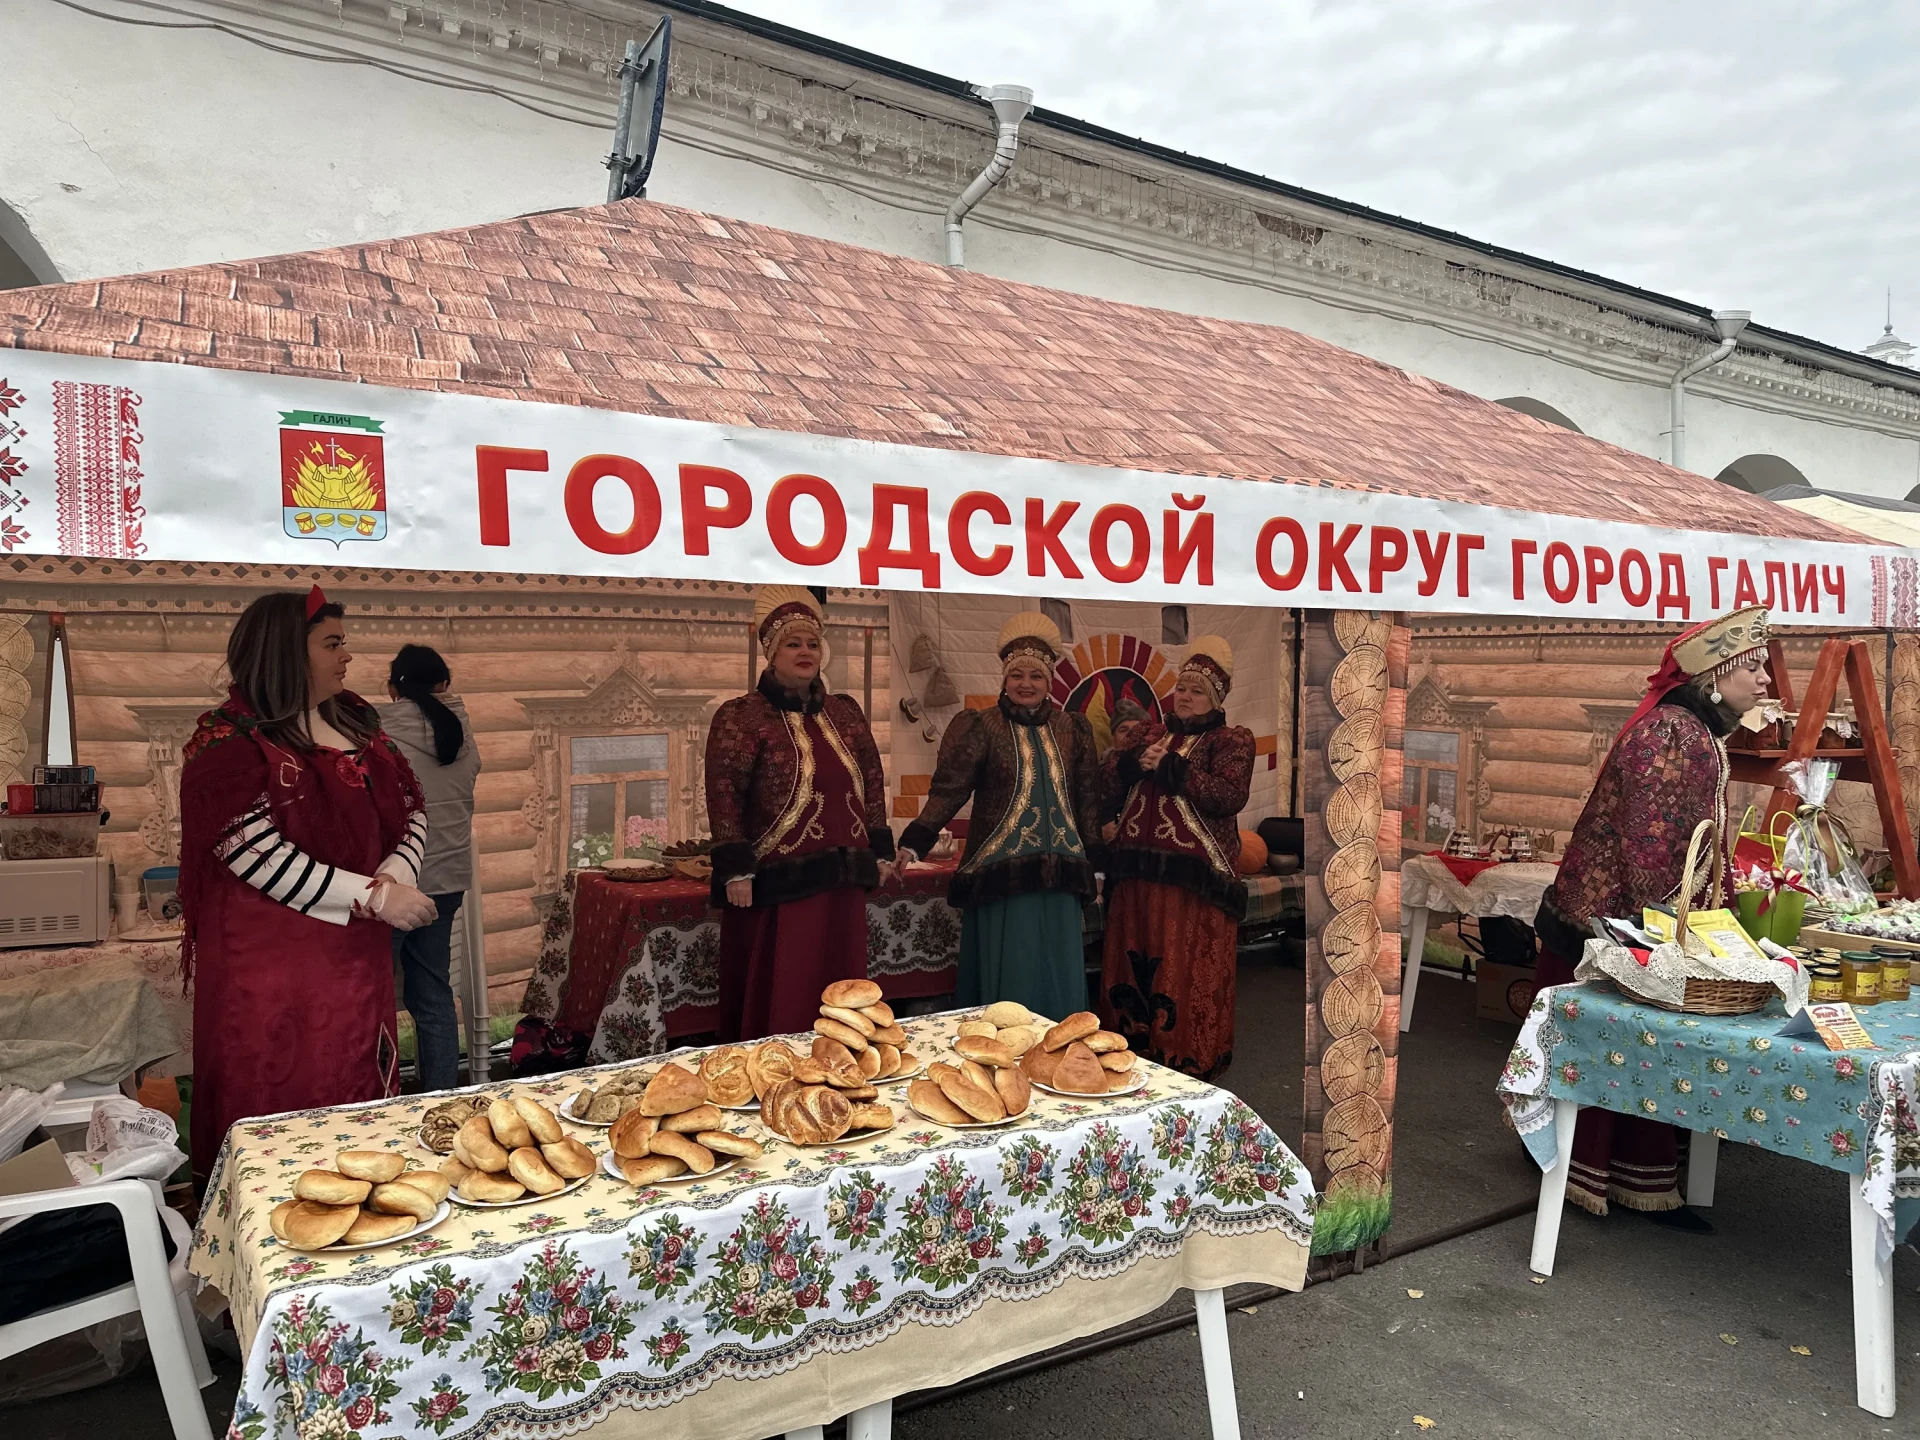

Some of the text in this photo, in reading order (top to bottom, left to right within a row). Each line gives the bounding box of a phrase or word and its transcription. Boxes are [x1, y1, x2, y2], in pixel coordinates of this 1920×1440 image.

[313, 414, 351, 425] ГАЛИЧ
[475, 445, 1846, 620] ГОРОДСКОЙ ОКРУГ ГОРОД ГАЛИЧ
